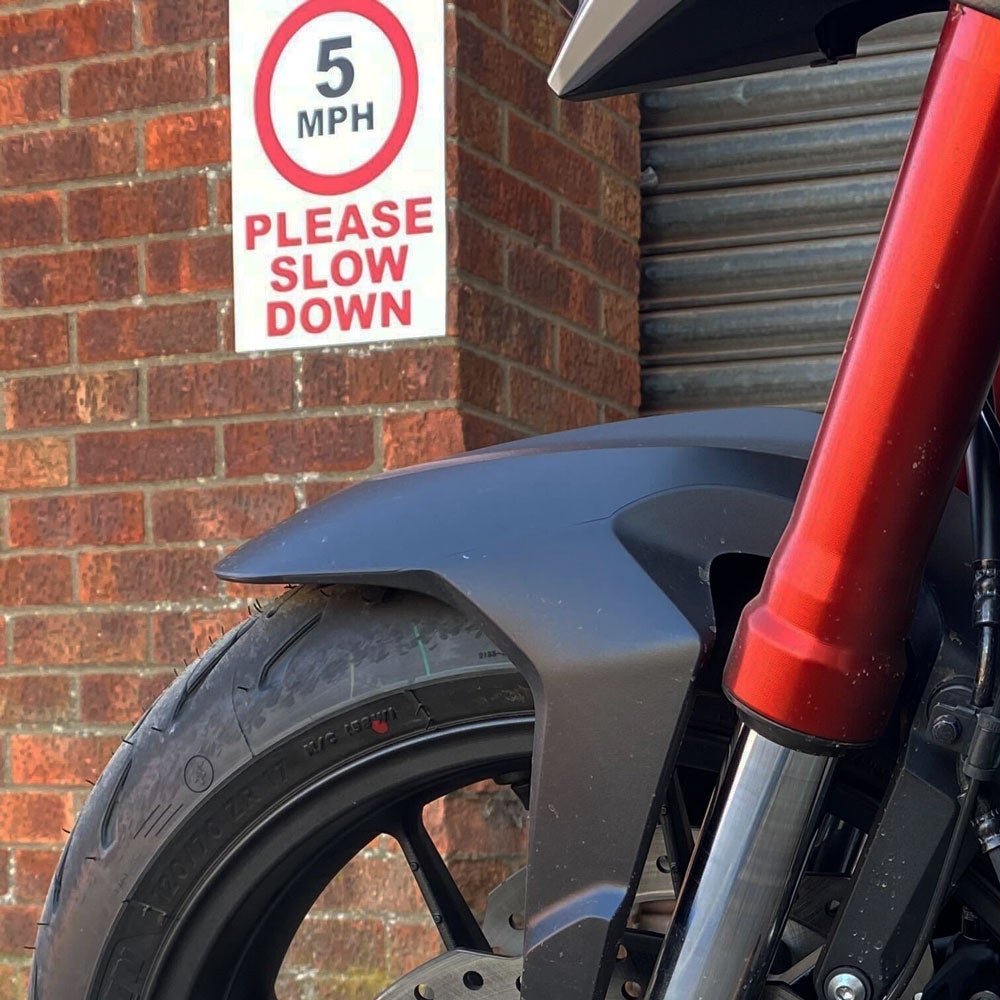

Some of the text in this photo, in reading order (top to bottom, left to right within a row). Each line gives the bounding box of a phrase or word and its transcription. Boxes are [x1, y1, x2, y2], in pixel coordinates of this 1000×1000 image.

[316, 35, 355, 99] 5
[297, 102, 374, 139] MPH
[245, 197, 433, 250] PLEASE
[270, 245, 409, 293] SLOW
[267, 290, 412, 337] DOWN
